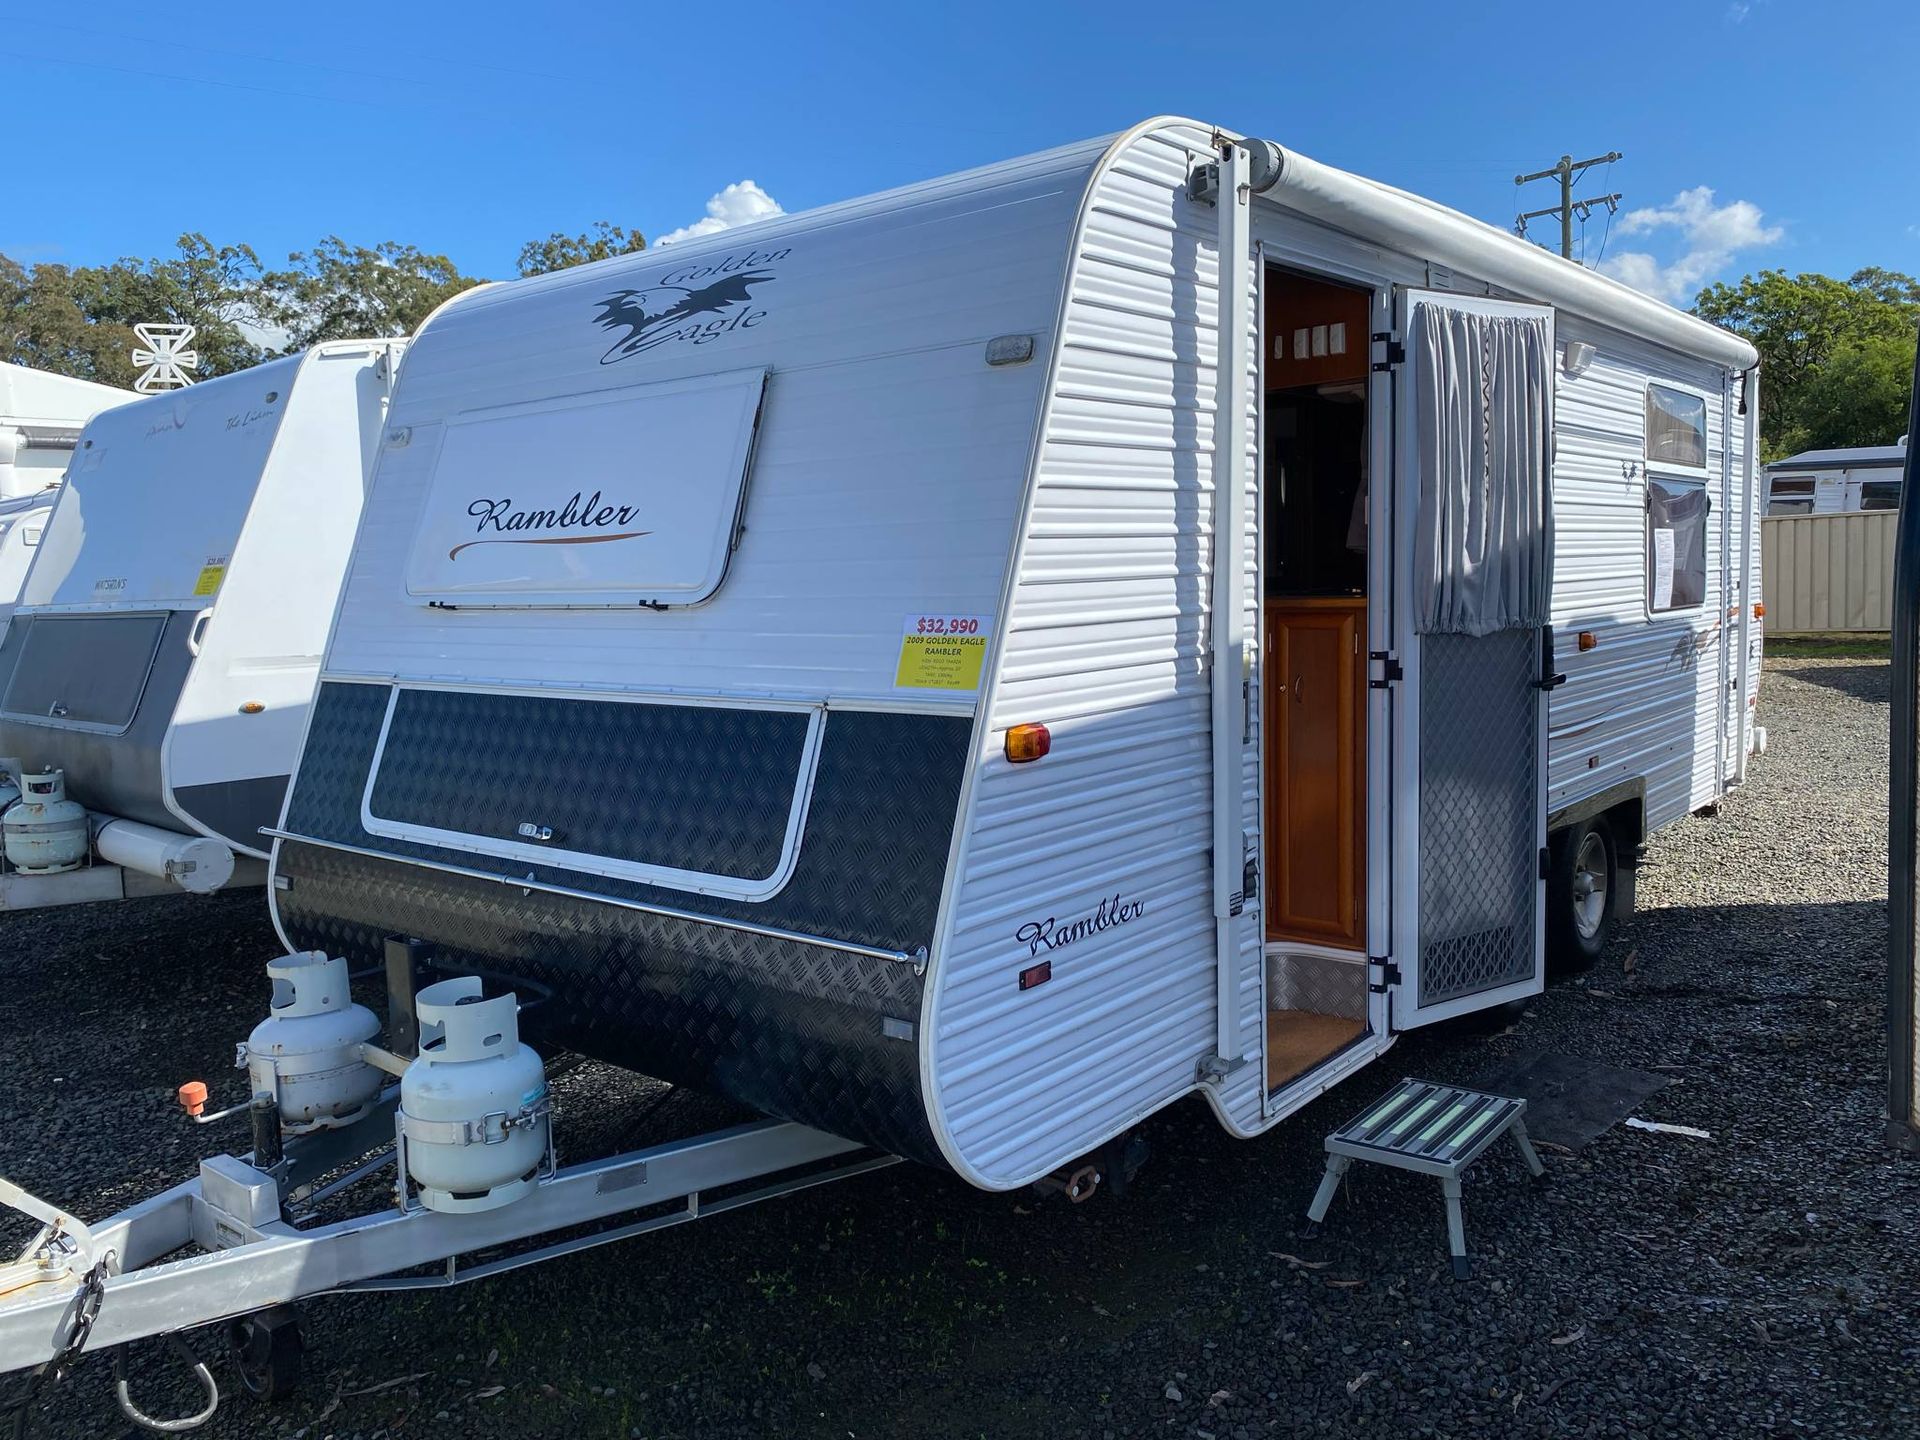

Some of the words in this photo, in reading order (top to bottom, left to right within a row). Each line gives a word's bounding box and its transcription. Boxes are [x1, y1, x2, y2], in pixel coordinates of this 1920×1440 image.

[659, 248, 792, 286] Golden
[600, 305, 767, 365] Eagle
[467, 490, 640, 533] Rambler
[906, 636, 925, 644] 2009
[926, 636, 958, 645] GOLDEN
[960, 637, 985, 646] EAGLE
[917, 616, 979, 636] $32,990
[924, 647, 962, 656] RAMBLER
[1015, 893, 1145, 956] Rambler
